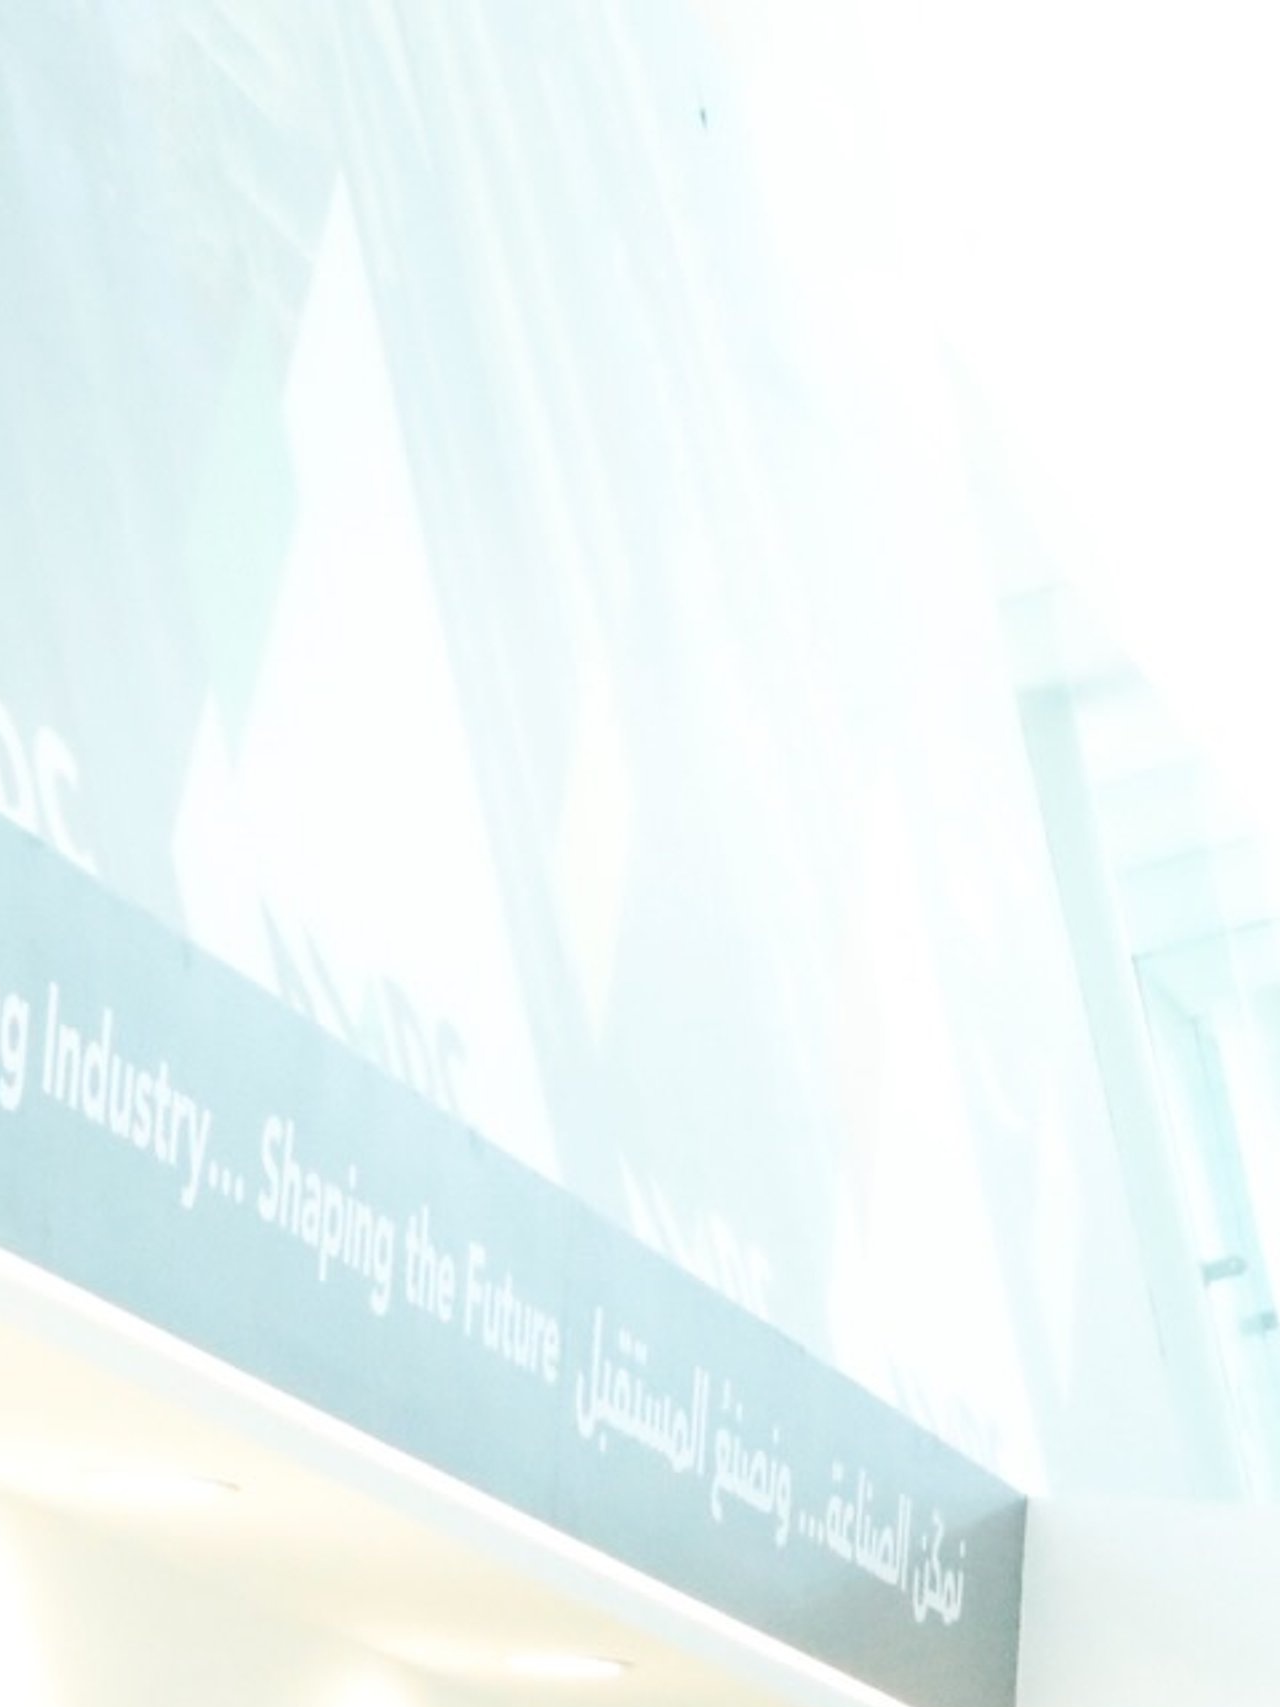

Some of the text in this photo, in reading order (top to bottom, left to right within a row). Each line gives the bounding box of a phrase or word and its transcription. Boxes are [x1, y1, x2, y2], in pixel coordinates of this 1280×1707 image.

[42, 985, 245, 1208] Industry...
[258, 1116, 395, 1313] Shaping
[404, 1206, 456, 1321] the
[465, 1243, 561, 1386] Future
[575, 1305, 708, 1478] المستقبل
